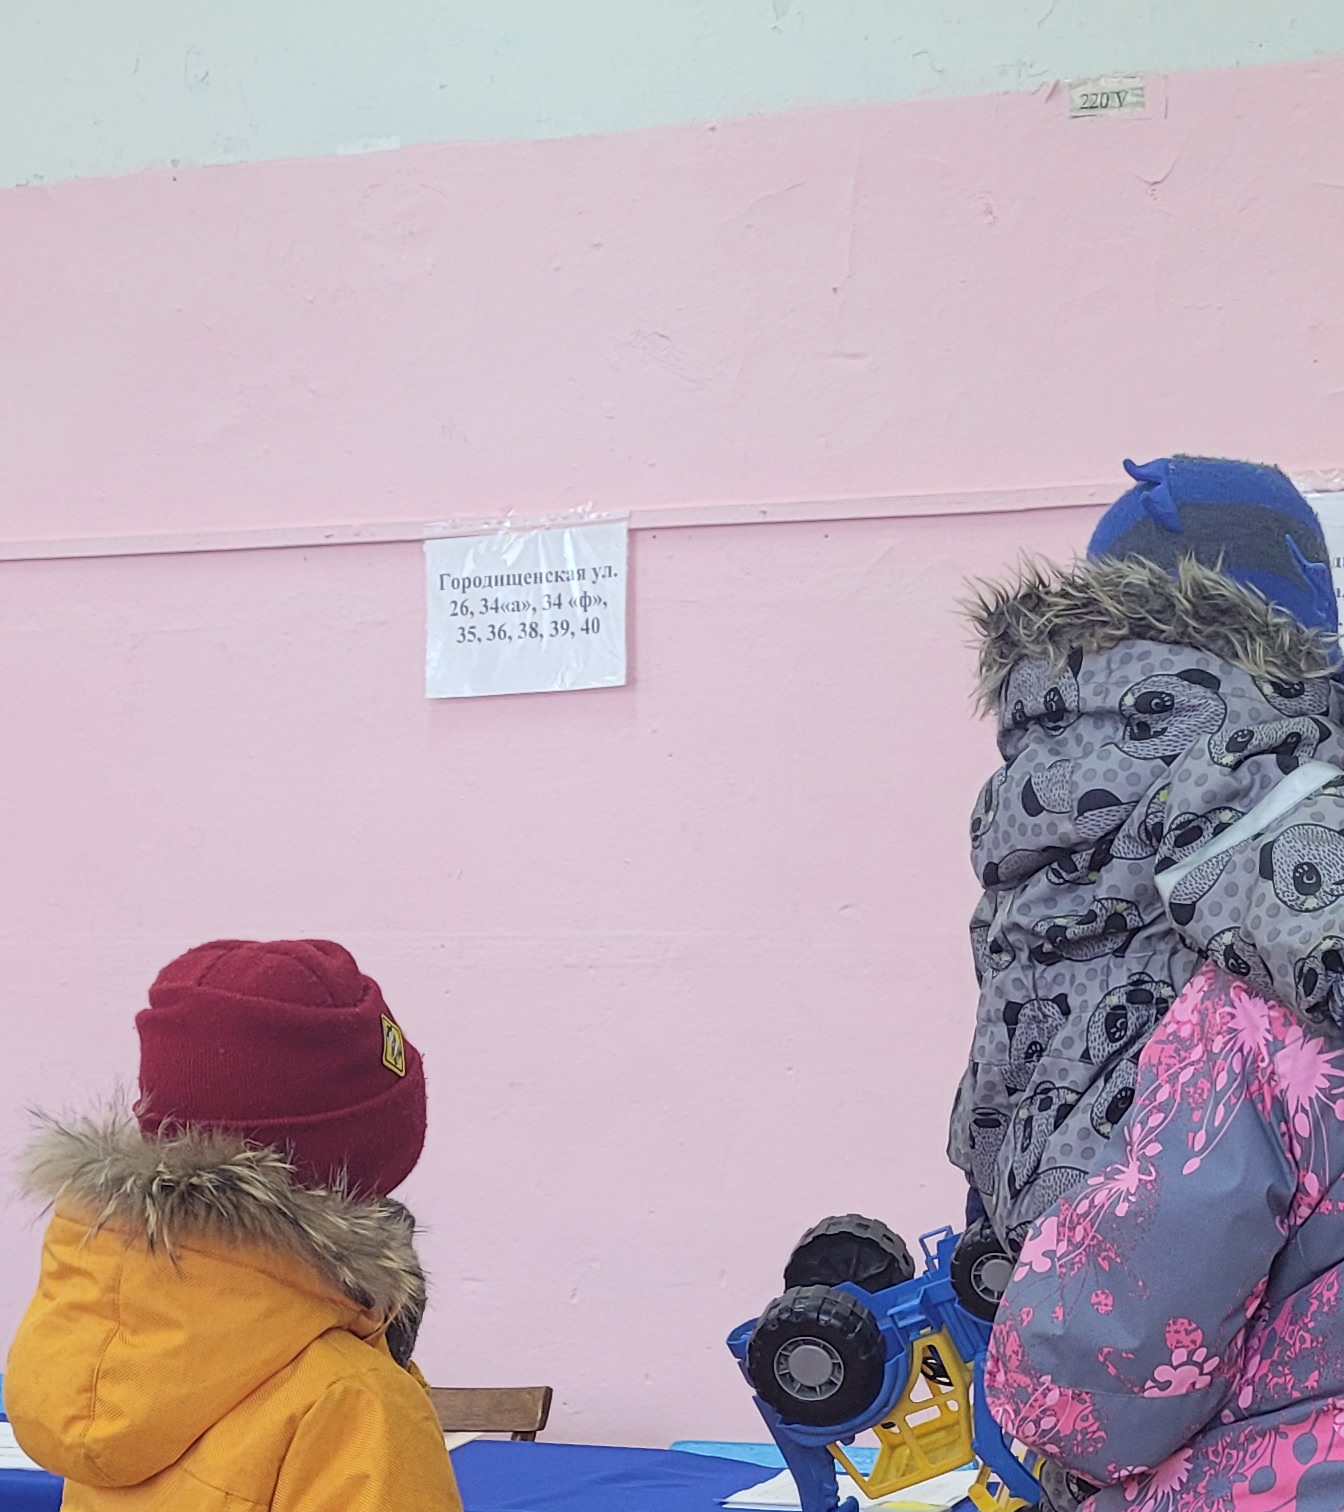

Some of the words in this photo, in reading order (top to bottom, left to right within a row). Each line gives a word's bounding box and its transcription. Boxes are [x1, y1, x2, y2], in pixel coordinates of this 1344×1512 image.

[1079, 92, 1110, 110] 220
[438, 568, 586, 593] Городищенская
[591, 564, 619, 585] ул.
[449, 597, 475, 619] 26,
[478, 596, 537, 616] 34«а»,
[541, 592, 563, 611] 34
[567, 590, 608, 613] «ф»,
[456, 625, 483, 644] 35,
[485, 622, 513, 642] 36,
[517, 621, 544, 642] 38,
[549, 619, 576, 639] 39,
[579, 616, 601, 635] 40
